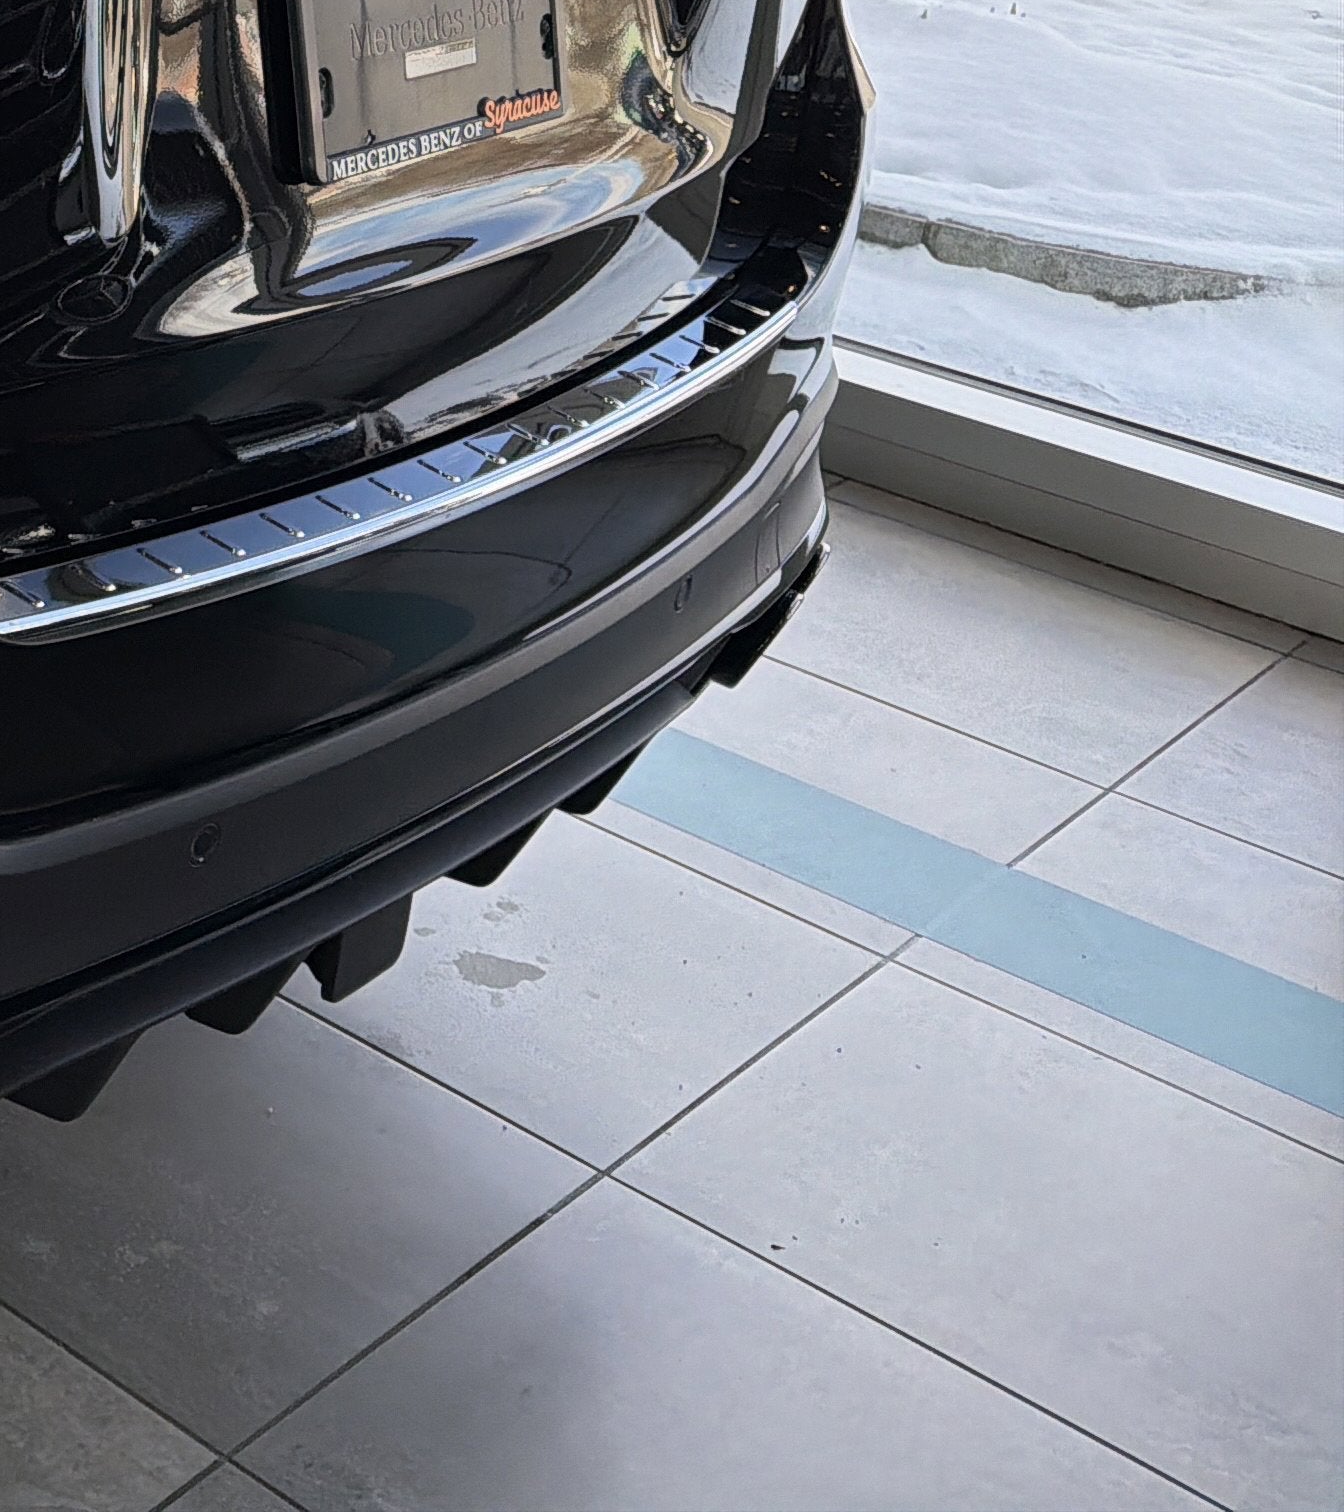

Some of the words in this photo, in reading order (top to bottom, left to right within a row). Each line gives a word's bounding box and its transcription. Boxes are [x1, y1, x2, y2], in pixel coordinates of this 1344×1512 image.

[332, 137, 417, 180] MERCEDES
[420, 126, 462, 155] BENZ
[463, 120, 484, 139] OF
[484, 90, 561, 134] Syracuse
